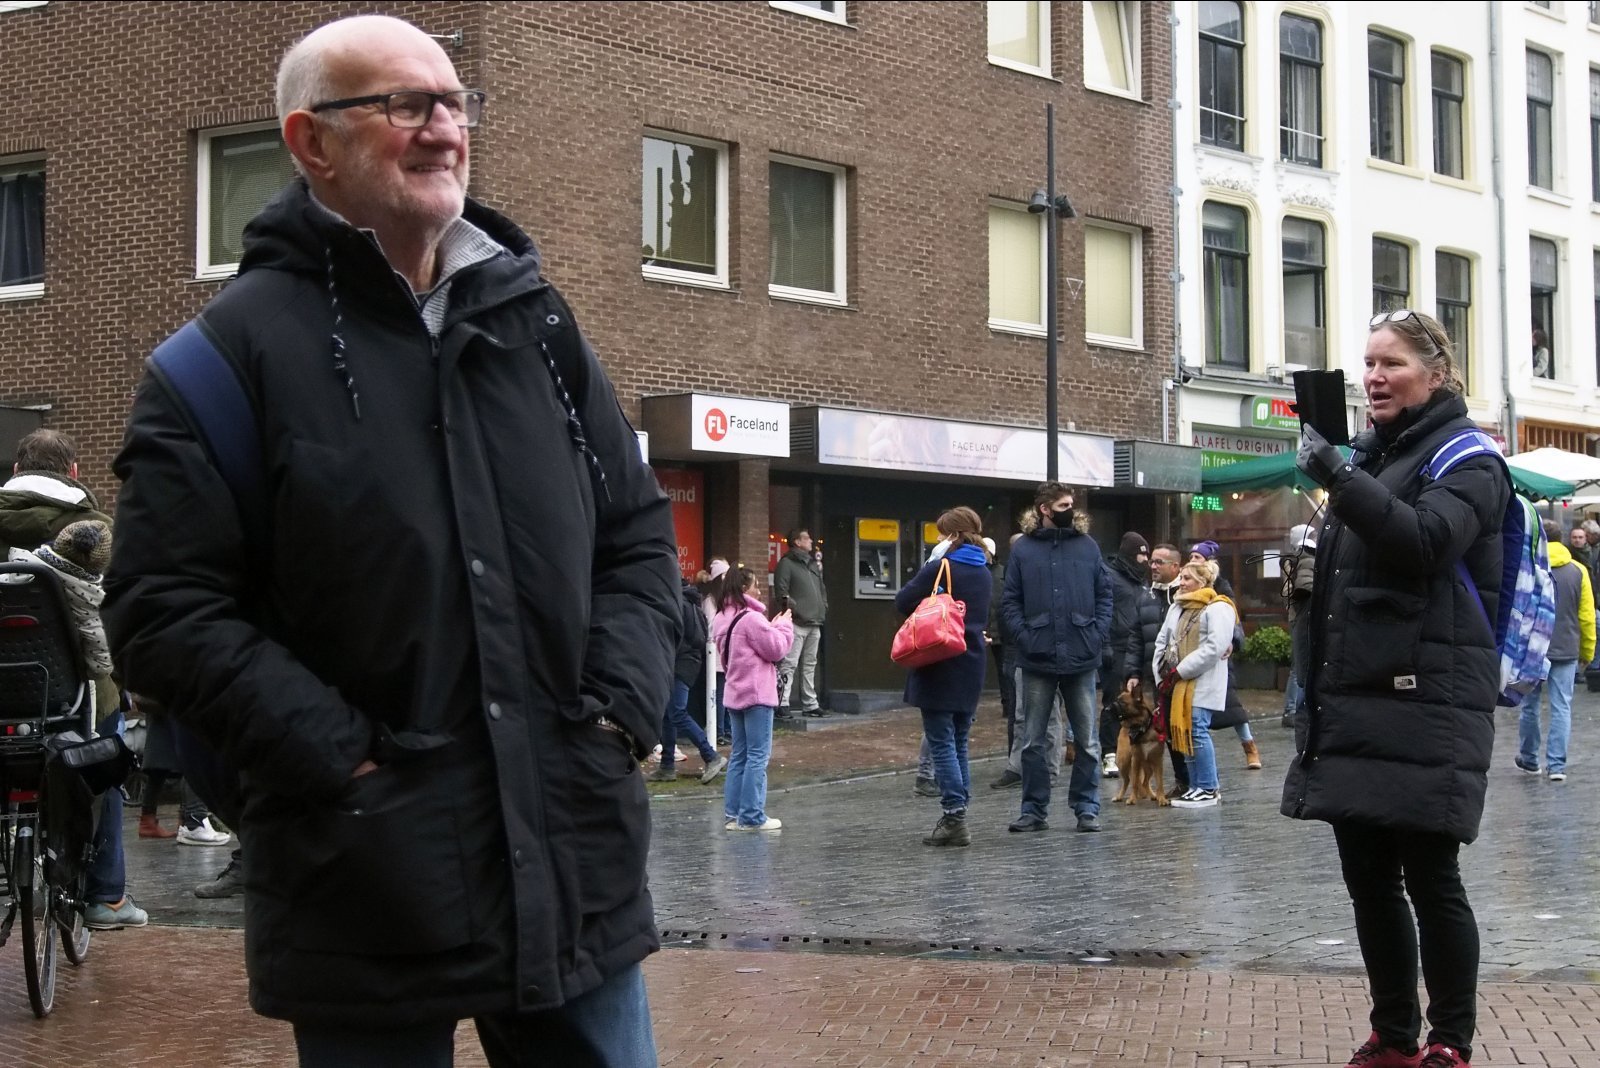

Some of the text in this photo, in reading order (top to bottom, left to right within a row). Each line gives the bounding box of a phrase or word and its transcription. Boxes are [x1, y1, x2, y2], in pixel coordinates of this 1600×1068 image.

[708, 415, 779, 435] FL Faceland
[952, 440, 999, 453] FACELAND
[1193, 435, 1231, 449] ALAFEL
[663, 483, 696, 503] land
[680, 559, 695, 571] d.nl
